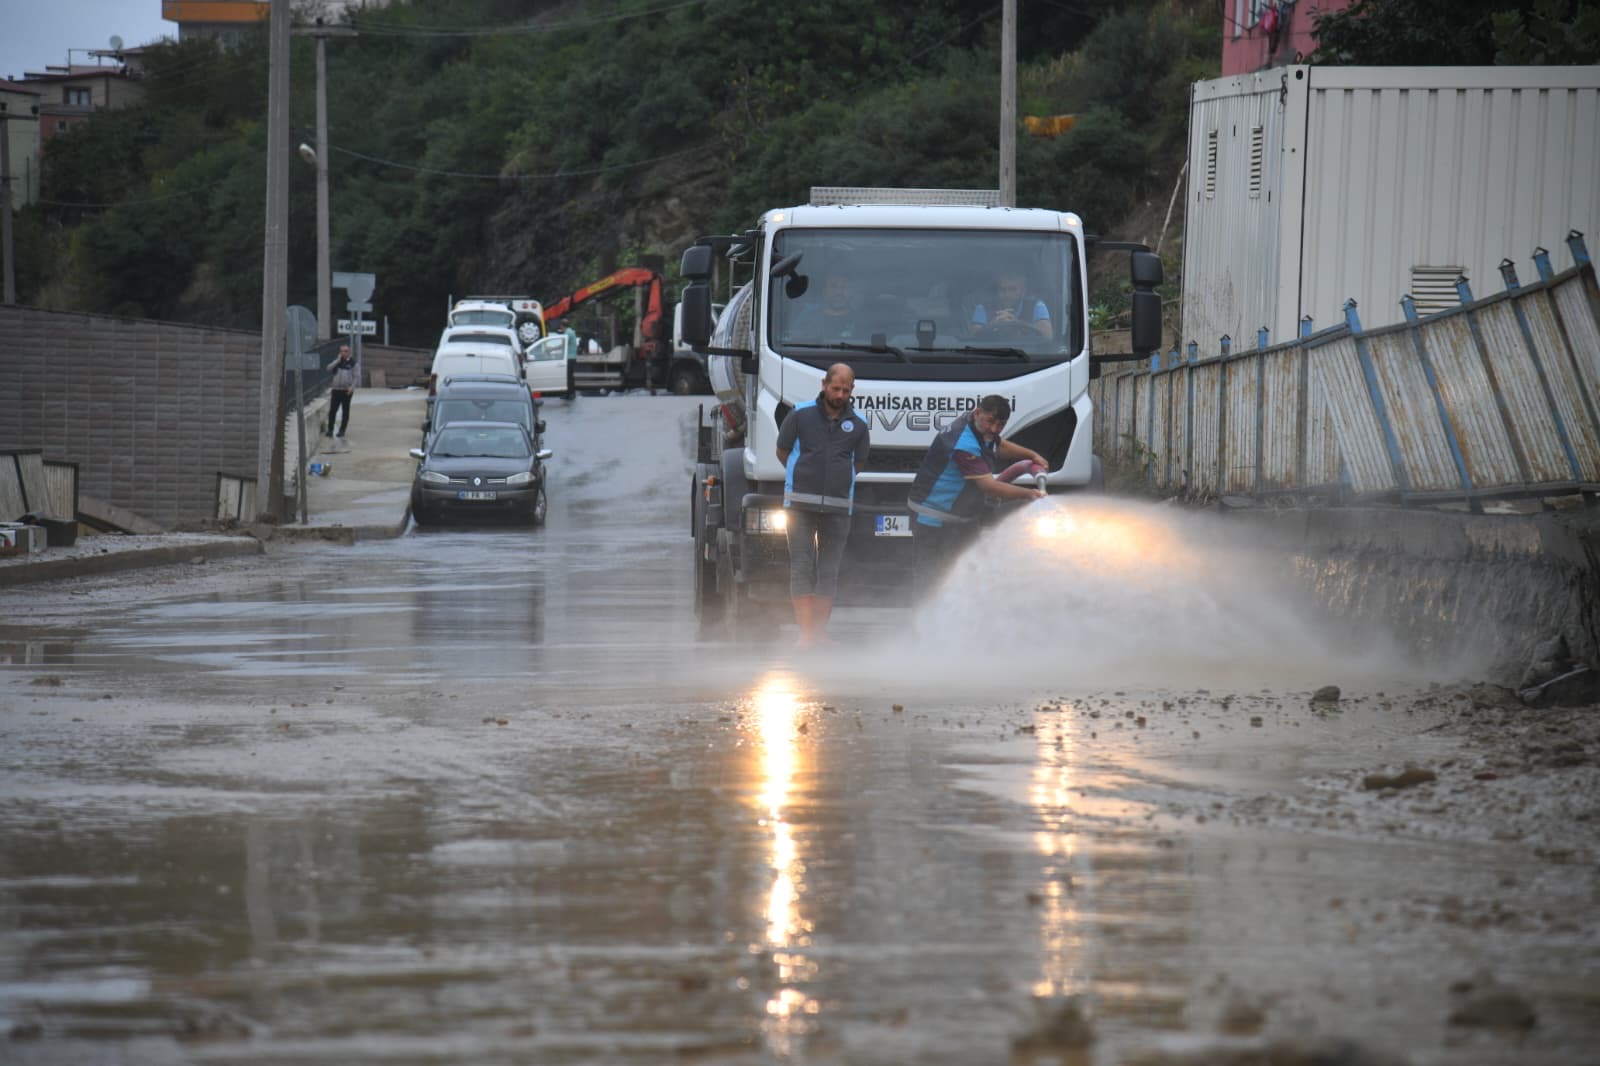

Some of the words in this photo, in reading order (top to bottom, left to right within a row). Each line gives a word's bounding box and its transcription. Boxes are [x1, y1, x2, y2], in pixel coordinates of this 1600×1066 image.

[849, 393, 922, 411] RTAHİSAR
[927, 394, 1016, 412] BELEDİİ
[865, 410, 958, 432] IVEC
[885, 517, 898, 531] 34
